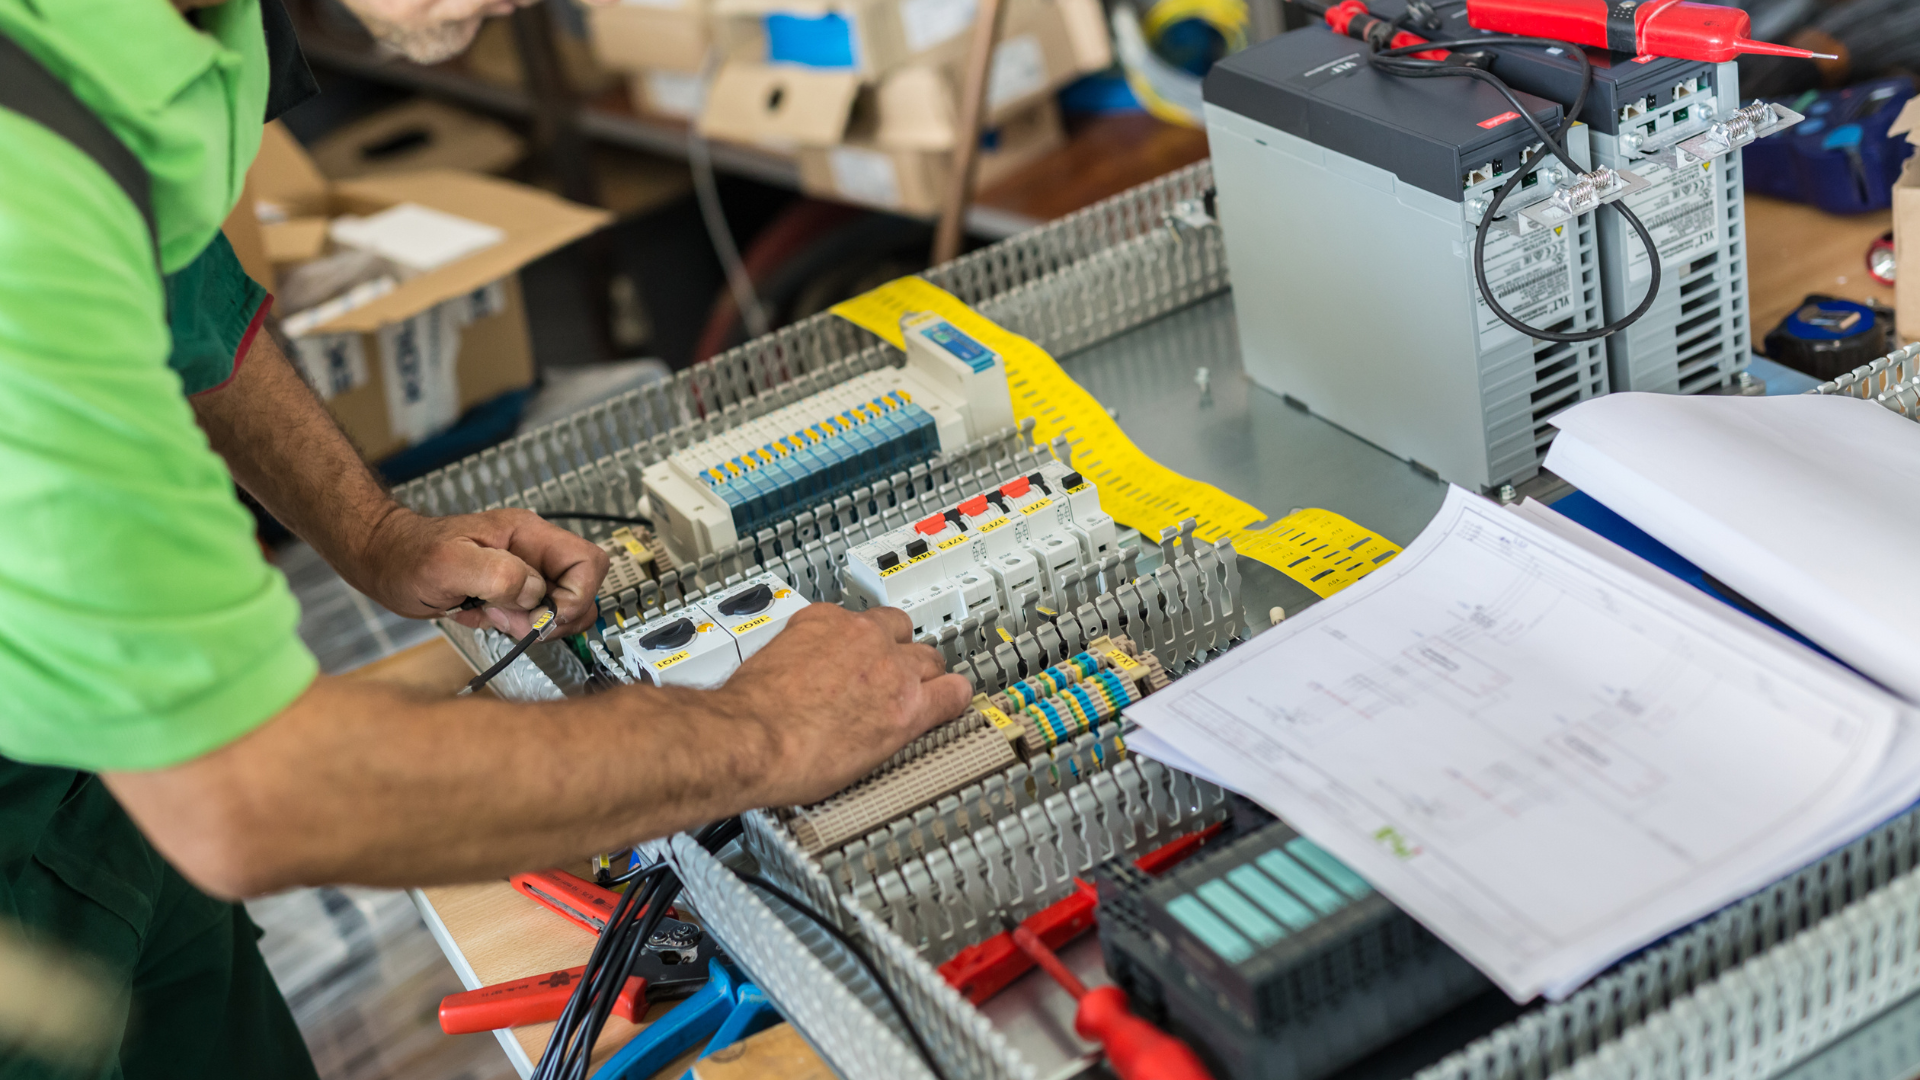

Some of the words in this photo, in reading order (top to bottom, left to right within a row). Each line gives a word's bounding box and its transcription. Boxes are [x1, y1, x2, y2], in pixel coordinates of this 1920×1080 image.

[1021, 499, 1050, 515] -17F1
[979, 517, 1010, 533] -17F2
[938, 535, 969, 550] -17F3
[736, 616, 771, 632] -18Q2
[657, 653, 690, 669] -19Q1
[1110, 650, 1133, 669] -17X1
[987, 708, 1007, 728] -2X1
